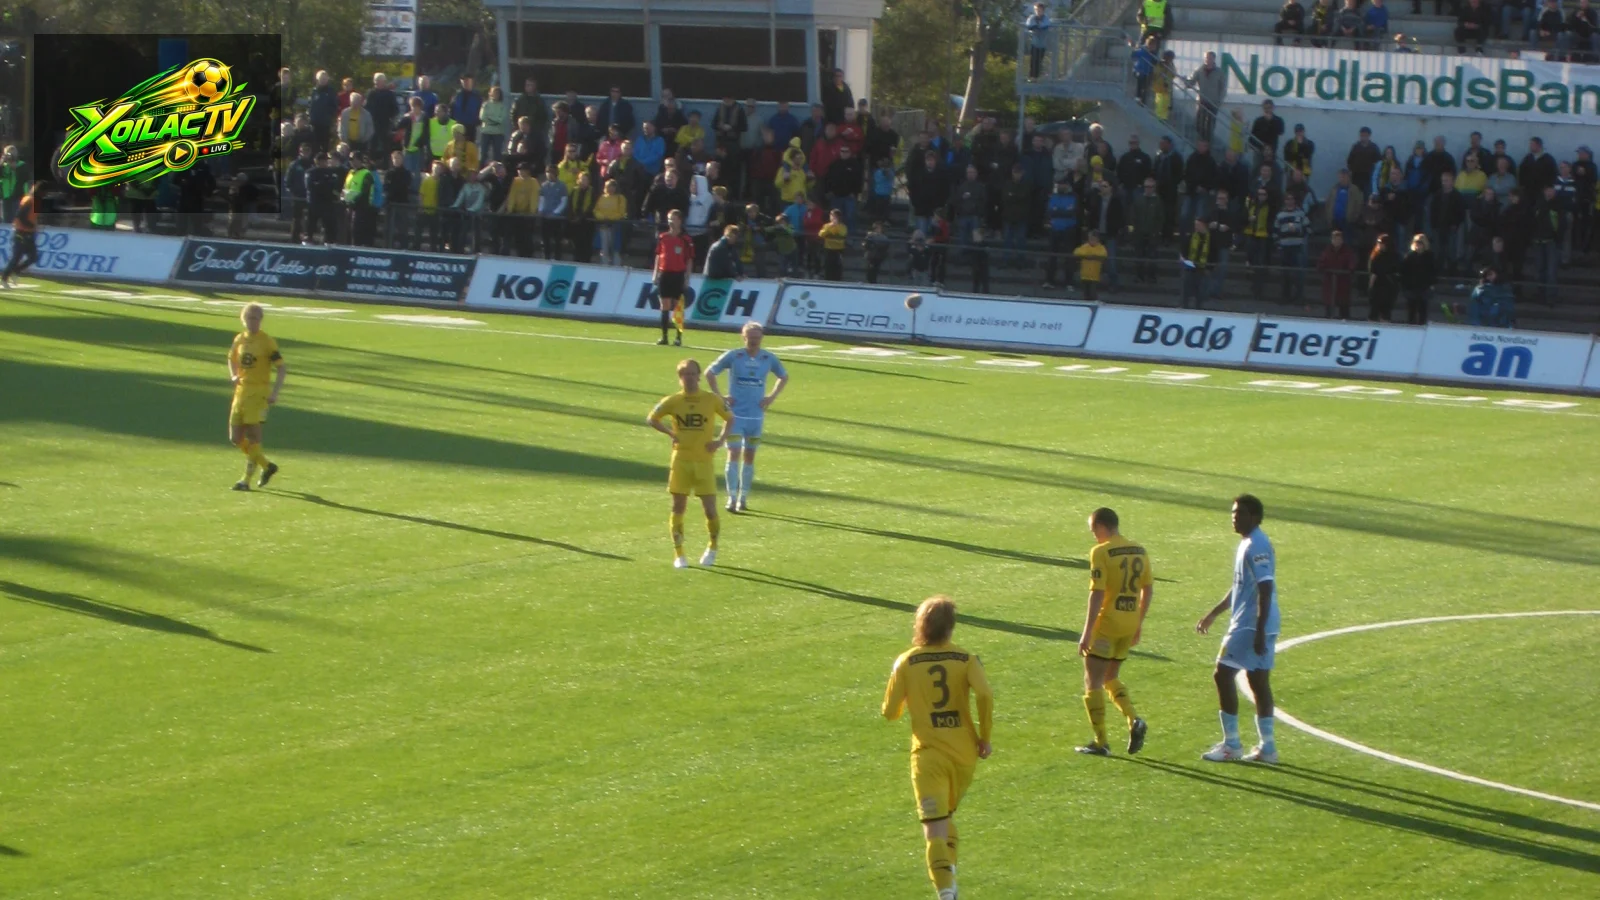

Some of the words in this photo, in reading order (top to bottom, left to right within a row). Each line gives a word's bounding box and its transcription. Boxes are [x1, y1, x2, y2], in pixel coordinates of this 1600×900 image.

[188, 245, 249, 272] Jacob
[250, 249, 313, 275] Klette
[234, 272, 280, 283] OPTIK
[491, 273, 599, 306] KOCH
[930, 313, 953, 323] Lett
[965, 316, 1019, 327] publisere
[1022, 320, 1036, 330] på
[1039, 322, 1062, 330] nett
[1133, 314, 1236, 352] Bodø
[1251, 322, 1380, 366] Energi
[1497, 335, 1538, 345] Nordland
[1461, 343, 1533, 379] an
[1119, 557, 1144, 593] 18
[928, 664, 950, 709] 3
